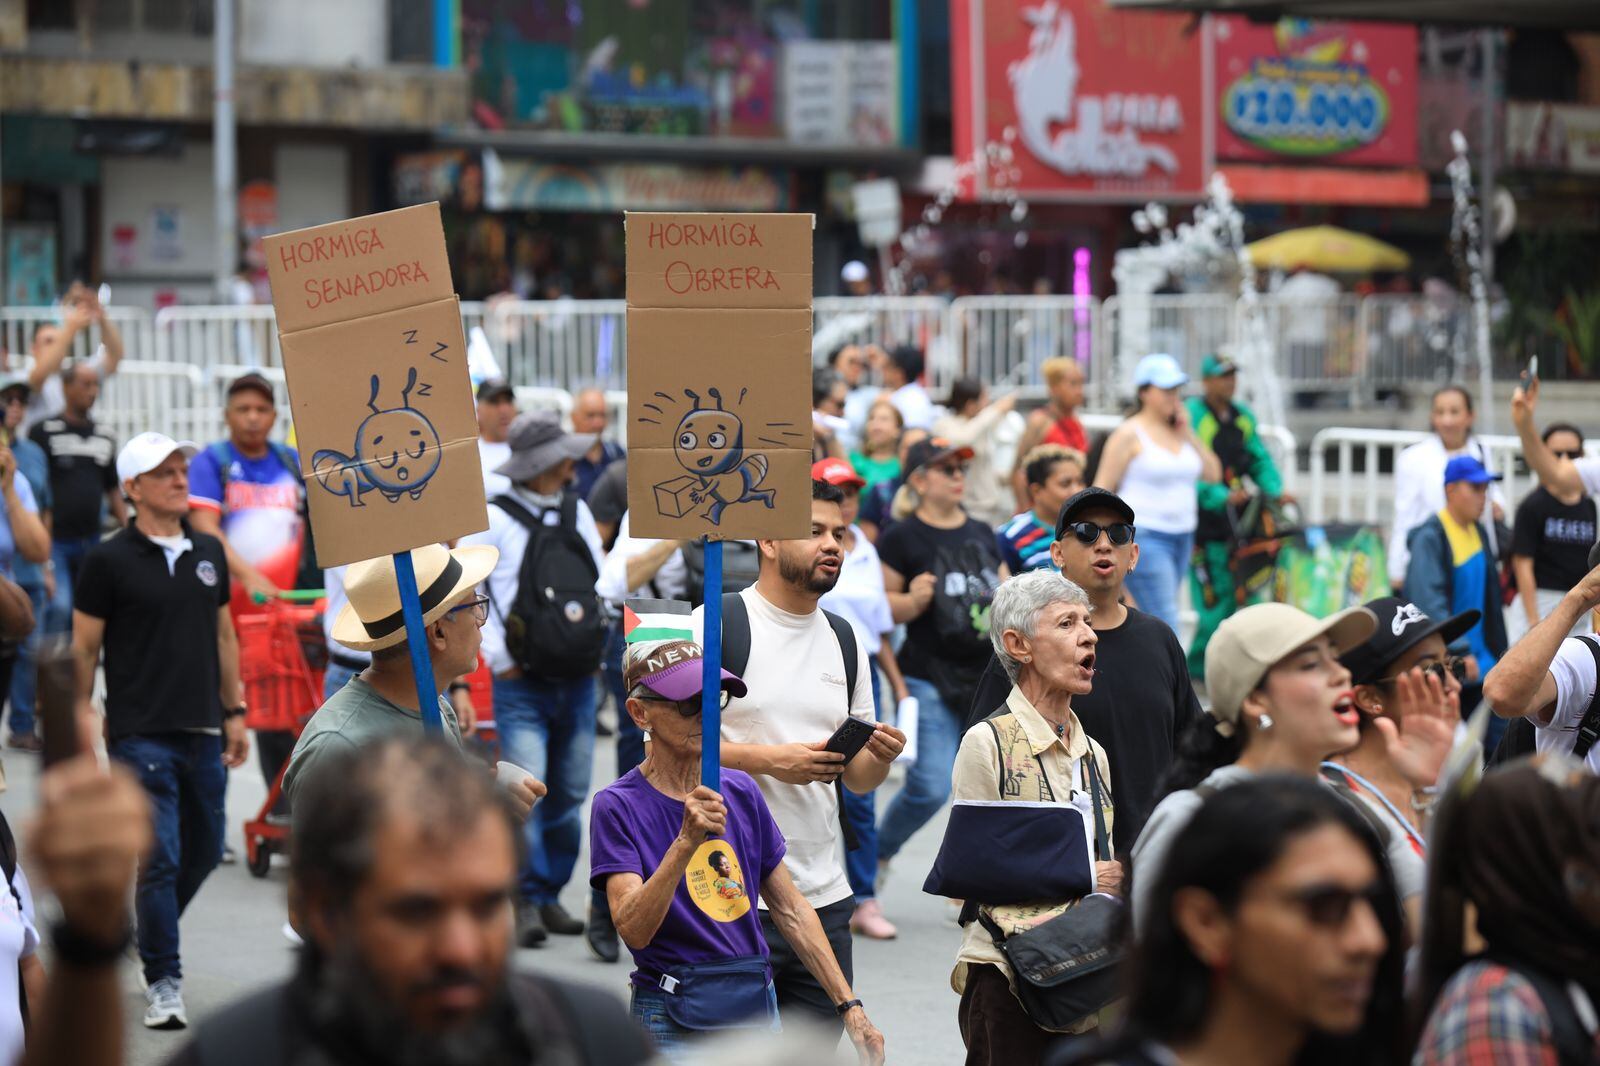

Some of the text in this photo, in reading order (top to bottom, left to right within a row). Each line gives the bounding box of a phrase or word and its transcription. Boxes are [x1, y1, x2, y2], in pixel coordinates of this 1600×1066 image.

[279, 228, 384, 272] HORMIGA
[648, 217, 762, 249] HORMIGA
[304, 260, 429, 309] SENADORA
[647, 645, 702, 672] NEW
